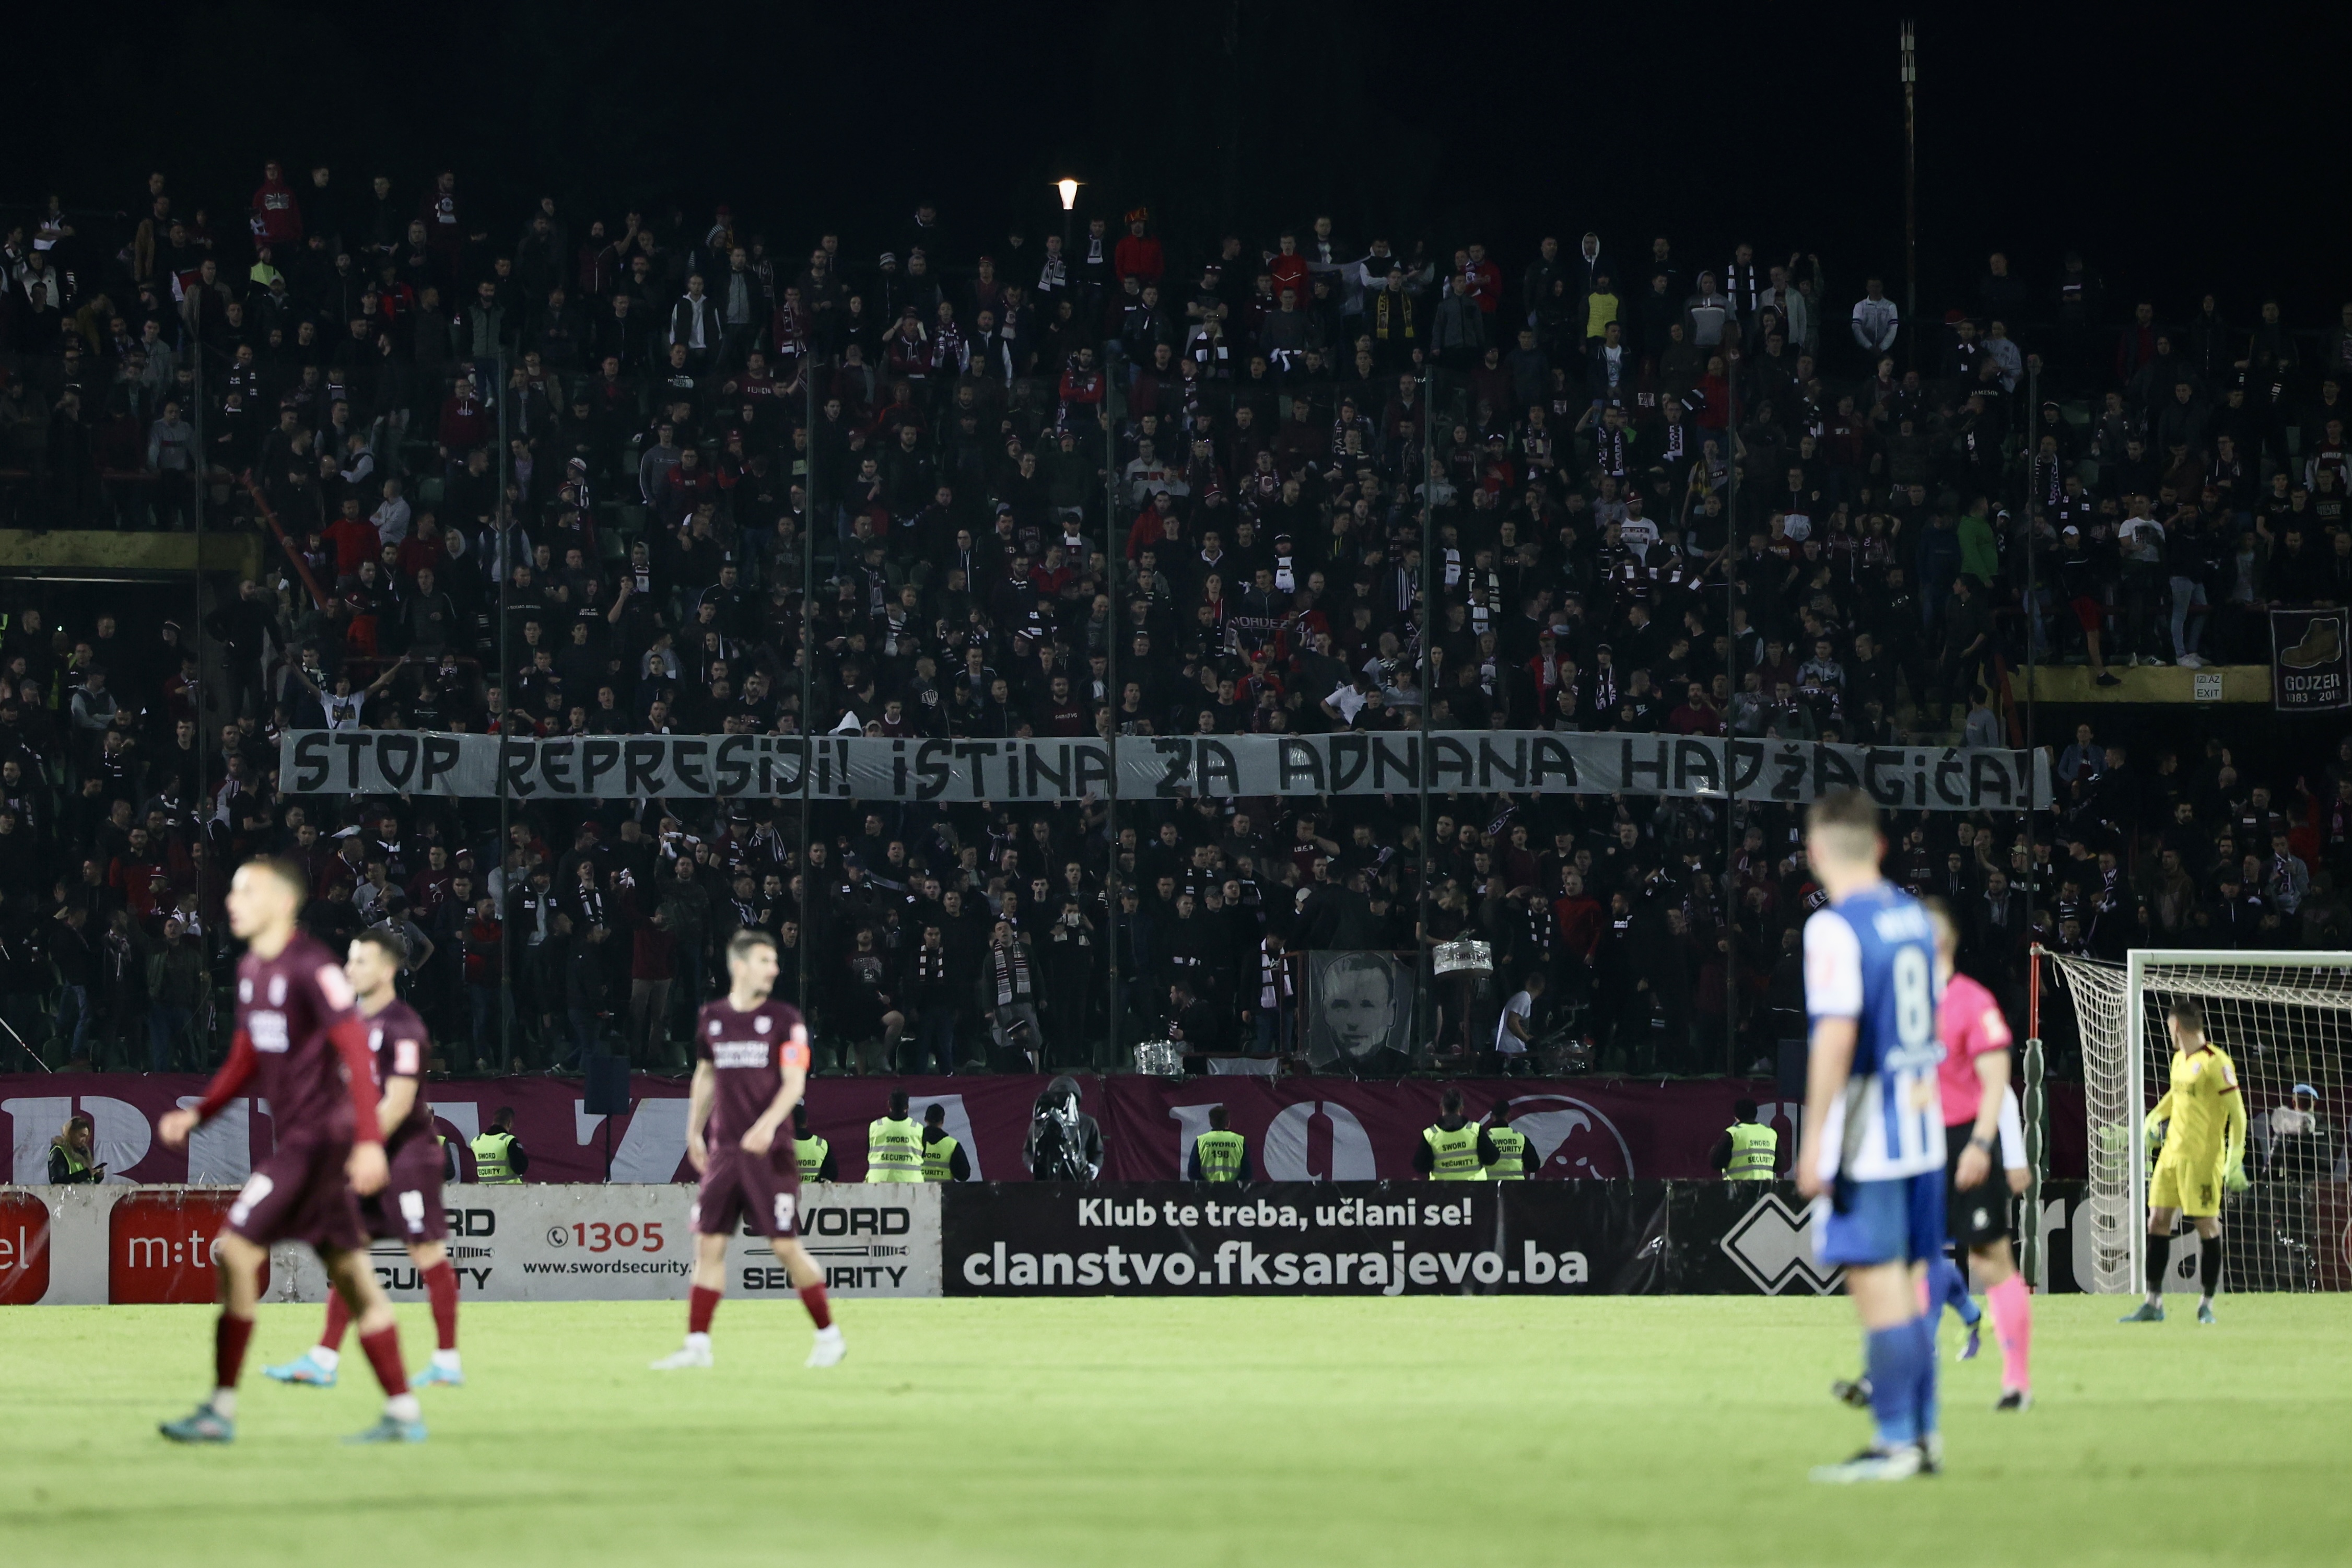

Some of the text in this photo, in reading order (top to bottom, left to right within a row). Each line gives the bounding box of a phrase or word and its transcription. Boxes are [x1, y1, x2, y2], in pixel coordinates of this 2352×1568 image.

[2197, 689, 2219, 697] EXIT
[2284, 673, 2341, 691] GOJZER
[294, 733, 460, 793] STOP
[1151, 738, 1240, 797] ZA
[1278, 735, 1578, 794] ADNANA
[881, 1153, 913, 1162] SECURITY
[1442, 1142, 1467, 1152] SWORD
[1079, 1198, 1472, 1231] Klub te treba, učlani se!
[572, 1222, 664, 1253] 1305
[963, 1240, 1589, 1296] clanstvo.fksarajevo.ba
